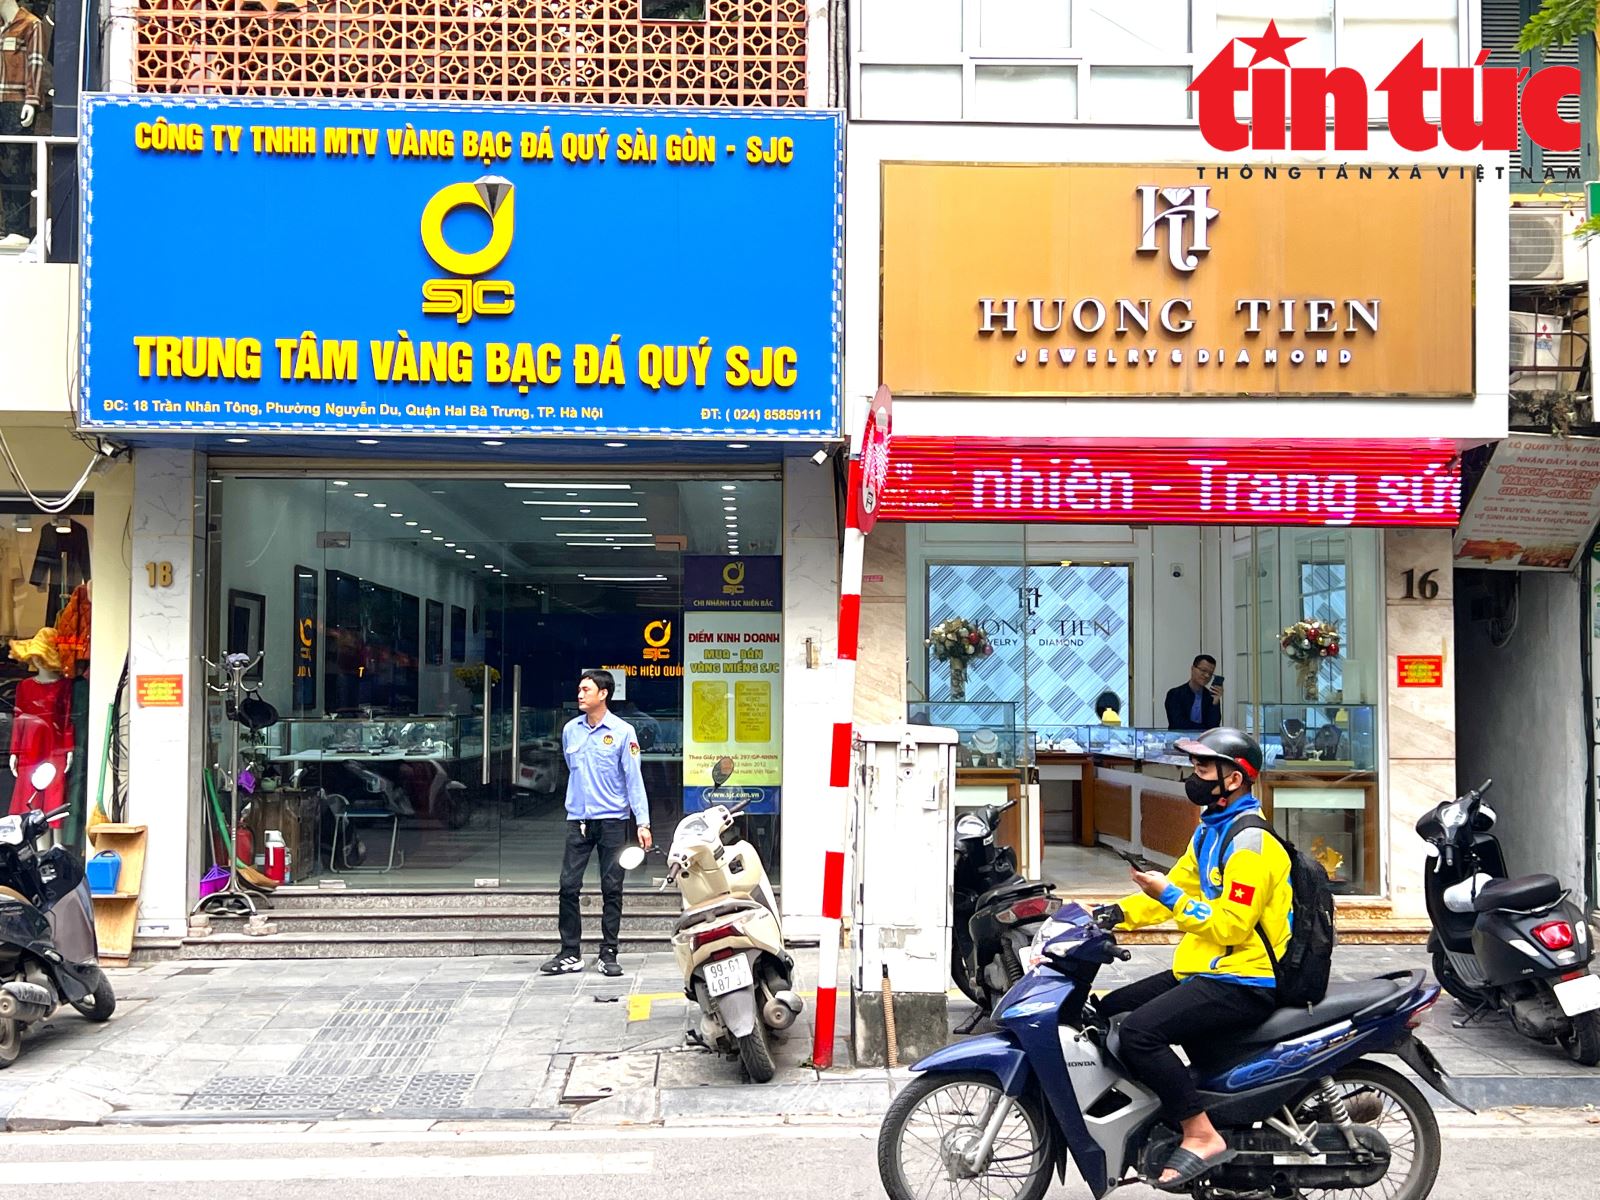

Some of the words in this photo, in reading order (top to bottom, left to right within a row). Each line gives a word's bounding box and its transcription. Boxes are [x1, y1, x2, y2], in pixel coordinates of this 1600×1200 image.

[135, 117, 203, 151] CÔNG
[211, 125, 242, 152] TY
[250, 125, 316, 155] TNHH
[324, 127, 378, 156] MTV
[387, 122, 455, 157] VÀNG
[462, 130, 512, 165] BẠC
[520, 126, 554, 159] ĐÁ
[561, 127, 610, 162] QUÝ
[617, 127, 658, 162] SÀI
[665, 128, 716, 164] GÒN
[726, 144, 736, 153] -
[746, 136, 794, 164] SJC
[978, 298, 1197, 334] HUONG
[1235, 298, 1381, 334] TIEN
[134, 336, 262, 379] TRUNG
[275, 330, 358, 381] TÂM
[370, 329, 473, 383] VÀNG
[486, 342, 562, 394] BẠC
[573, 334, 626, 386] ĐÁ
[638, 336, 712, 389] QUÝ
[725, 345, 798, 388] SJC
[1015, 348, 1158, 366] JEWELRY
[1197, 348, 1352, 366] DIAMOND
[103, 399, 129, 412] ĐC:
[132, 400, 149, 412] 18
[152, 397, 181, 412] Trần
[185, 400, 220, 413] Nhân
[224, 400, 262, 416] Tông,
[266, 401, 320, 417] Phường
[325, 401, 376, 418] Nguyễn
[380, 403, 401, 417] Du,
[406, 404, 441, 419] Quận
[445, 404, 466, 417] Hai
[470, 405, 487, 418] Bà
[491, 405, 534, 420] Trưng,
[537, 406, 556, 418] TP.
[560, 406, 578, 419] Hà
[581, 406, 603, 421] Nội
[701, 408, 721, 420] ĐT:
[764, 409, 821, 420] 85859111
[972, 458, 1133, 509] nhiên
[1187, 459, 1357, 525] Trang
[145, 561, 173, 588] 18
[1400, 568, 1439, 600] 16
[688, 629, 714, 643] ĐIỂM
[717, 633, 740, 643] KINH
[744, 633, 780, 643] DOANH
[1038, 638, 1084, 647] DIAMOND
[703, 649, 731, 660] MUA
[740, 647, 763, 660] BÁN
[640, 664, 661, 679] HIỆU
[690, 661, 721, 674] VÀNG
[723, 660, 759, 674] MIẾNG
[760, 663, 780, 673] SJC
